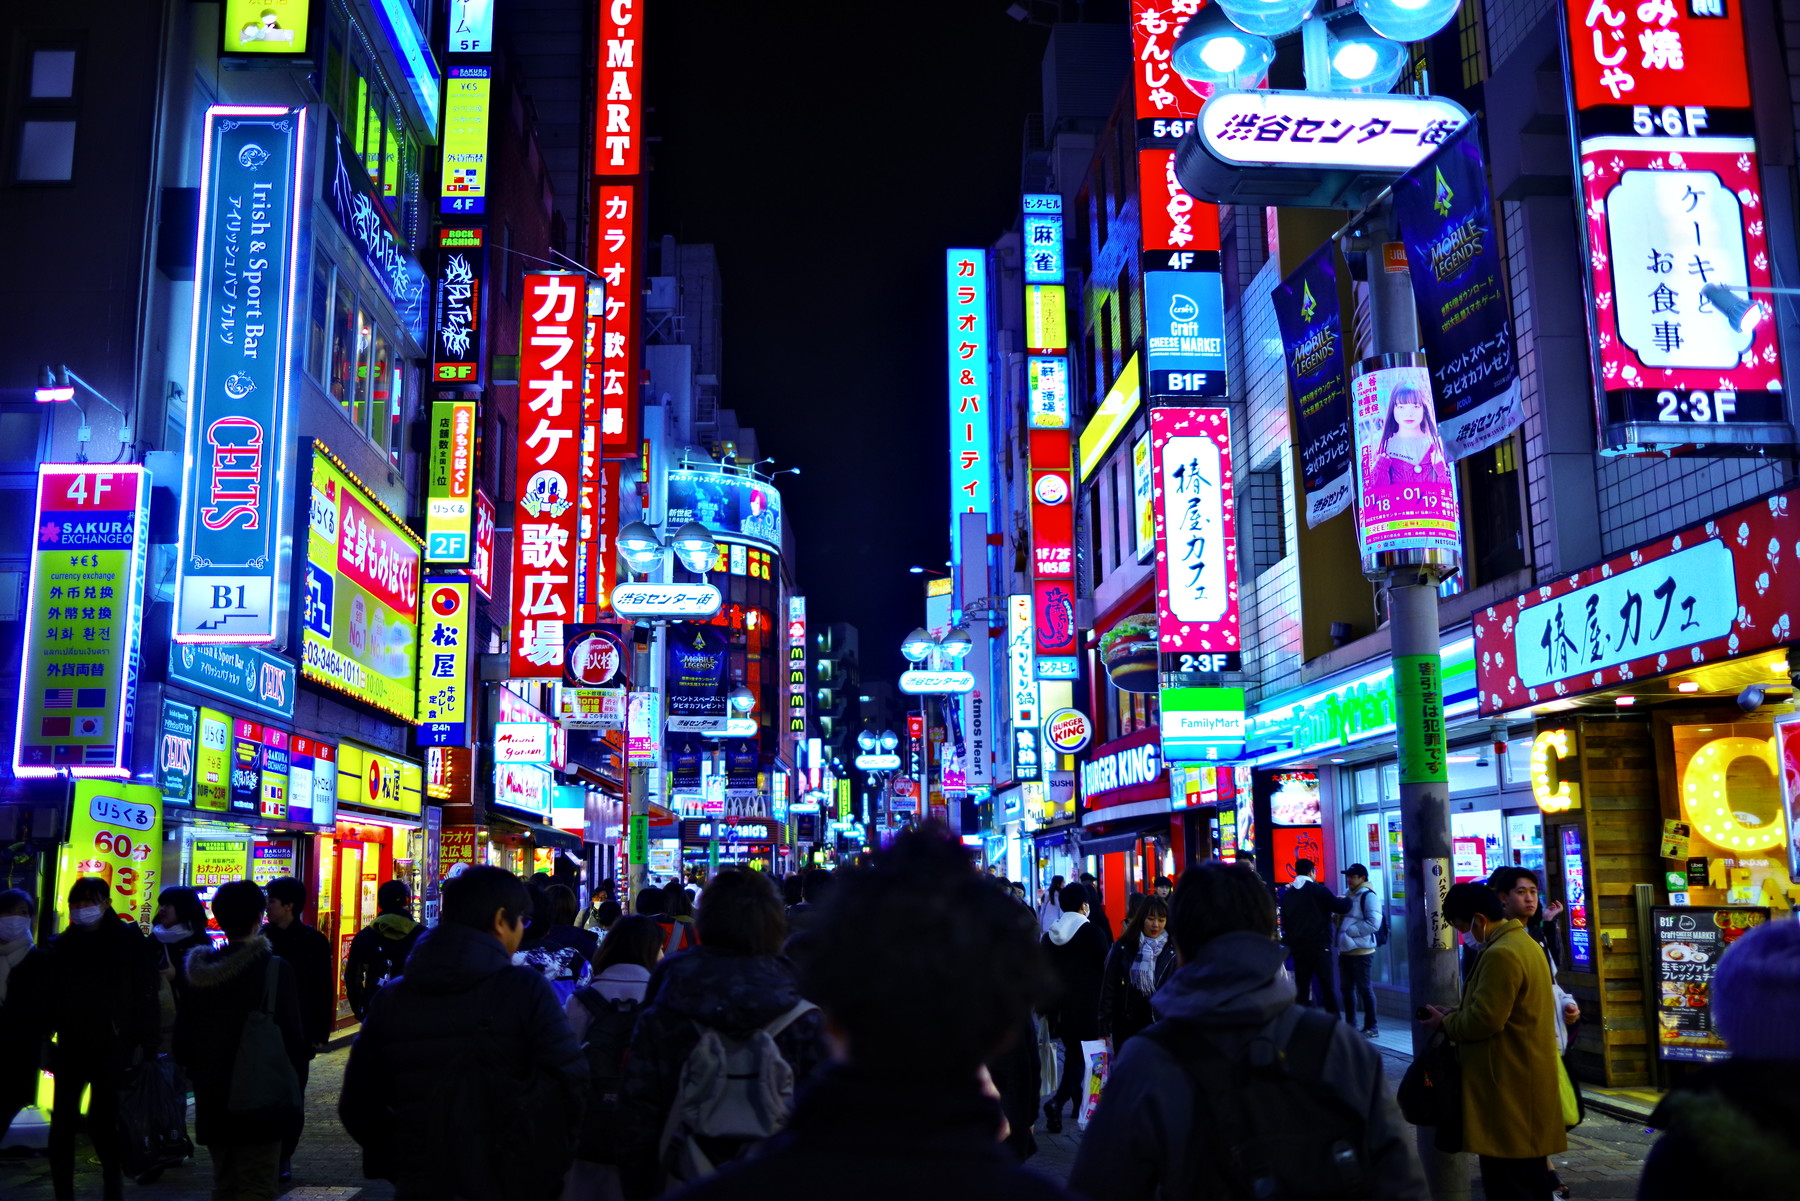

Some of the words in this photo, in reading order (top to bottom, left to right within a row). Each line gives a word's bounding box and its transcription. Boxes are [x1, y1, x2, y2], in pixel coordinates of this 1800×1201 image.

[460, 40, 480, 50] 5F
[1140, 8, 1174, 110] もんじゃ
[1217, 113, 1460, 147] 渋谷センター街
[251, 182, 272, 236] Irish
[453, 199, 474, 210] 4F
[1024, 199, 1061, 209] センタービル
[250, 240, 268, 253] &
[442, 238, 481, 246] FASHION
[448, 230, 473, 238] ROCK
[1430, 218, 1483, 262] MOBILE
[224, 196, 242, 299] アイリッシュパブ
[1034, 226, 1055, 272] 麻雀
[1434, 237, 1484, 283] LEGENDS
[1681, 185, 1715, 314] ケーキと
[1168, 252, 1195, 270] 4F
[243, 258, 268, 324] Sport
[1647, 248, 1684, 353] お食事
[1173, 304, 1194, 313] craft
[219, 304, 237, 345] ケルツ
[1171, 322, 1199, 337] Craft
[243, 323, 266, 359] Bar
[1150, 337, 1180, 348] CHEESE
[1181, 337, 1221, 353] MARKET
[1294, 326, 1332, 364] MOBILE
[439, 366, 471, 378] 3F
[525, 277, 576, 466] カラオケ
[1296, 341, 1335, 378] LEGENDS
[1168, 373, 1206, 391] B1F
[436, 418, 450, 486] 店舗数全国1位
[453, 409, 471, 495] 全身もみほぐし
[201, 415, 264, 530] CELTS
[66, 474, 114, 505] 4F
[668, 509, 693, 517] 新世紀
[61, 534, 122, 544] EXCHANGE
[62, 522, 134, 535] SAKURA
[1171, 458, 1213, 600] 椿屋カフェ
[136, 507, 148, 588] MONEY
[342, 505, 417, 608] 全身もみほぐし
[435, 537, 462, 554] 2F
[1036, 547, 1071, 560] 1F/2F
[50, 572, 81, 581] currency
[82, 571, 116, 580] exchange
[210, 584, 248, 609] B1
[519, 522, 569, 667] 歌広場
[617, 593, 715, 605] 渋谷センター街
[46, 627, 74, 641] 외화
[82, 627, 111, 641] 환전
[349, 620, 368, 651] No.1
[1541, 576, 1700, 677] 椿屋カフェ
[219, 647, 235, 666] Sport
[234, 656, 245, 670] Bar
[307, 643, 361, 684] 03-3464-1011
[431, 623, 459, 679] 松屋
[684, 655, 715, 664] MOBILE
[47, 663, 104, 677] 外貨両替
[124, 604, 141, 736] EXCHANGE
[906, 677, 970, 686] 渋谷センター街
[260, 662, 286, 707] CELTS
[428, 696, 438, 719] 定食
[438, 690, 447, 715] カレー
[447, 686, 456, 711] 牛めし
[972, 690, 983, 737] atmos
[1053, 717, 1083, 733] BURGER
[1180, 718, 1239, 729] FamilyMart
[1418, 662, 1442, 775] 客引きは犯罪です
[204, 724, 225, 745] りらくる
[432, 724, 451, 732] 24h
[1054, 727, 1085, 743] KING
[161, 733, 192, 776] CELTS
[267, 751, 288, 763] SAKURA
[972, 739, 983, 776] Heart
[1017, 768, 1037, 778] B1F
[1085, 752, 1118, 796] BURGER
[1117, 743, 1156, 786] KING
[1530, 729, 1572, 812] C
[382, 769, 400, 801] 松屋
[1050, 780, 1074, 788] SUSHI
[97, 801, 148, 825] りらくる
[94, 830, 152, 861] 60分
[196, 865, 243, 873] おたからや
[1660, 917, 1674, 927] B1F
[1660, 931, 1676, 939] Craft
[1693, 931, 1716, 940] MARKET
